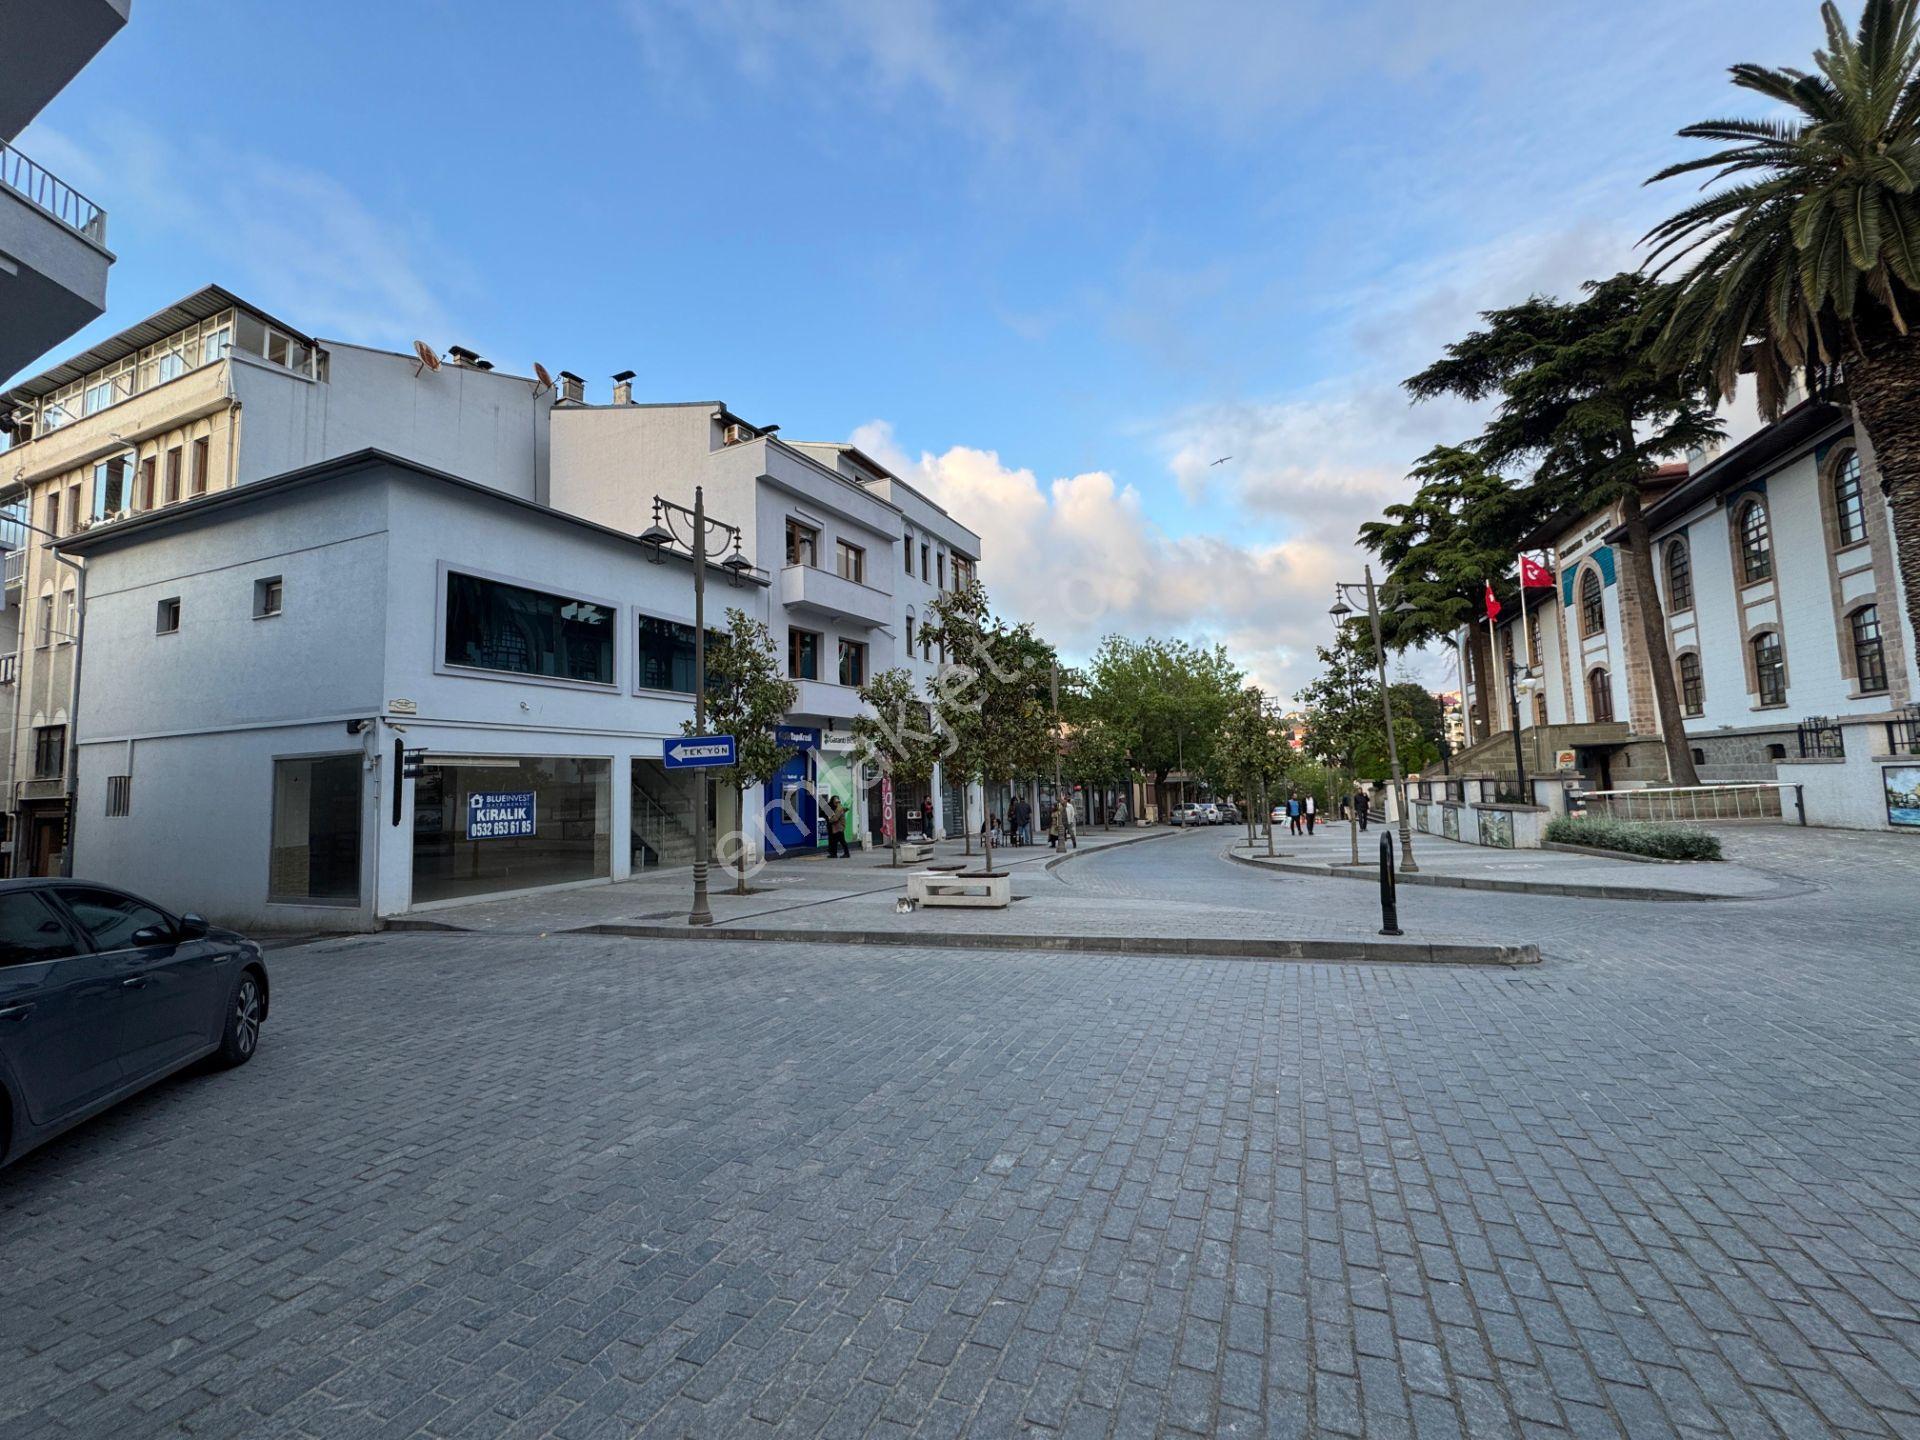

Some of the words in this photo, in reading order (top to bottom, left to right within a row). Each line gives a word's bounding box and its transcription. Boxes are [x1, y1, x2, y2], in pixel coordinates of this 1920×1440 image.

[683, 748, 703, 756] TEK
[707, 745, 728, 755] YÖN
[486, 794, 530, 803] BLUEINVEST
[471, 823, 492, 837] 0532
[493, 821, 509, 835] 653
[510, 821, 520, 834] 61
[521, 820, 532, 833] 85
